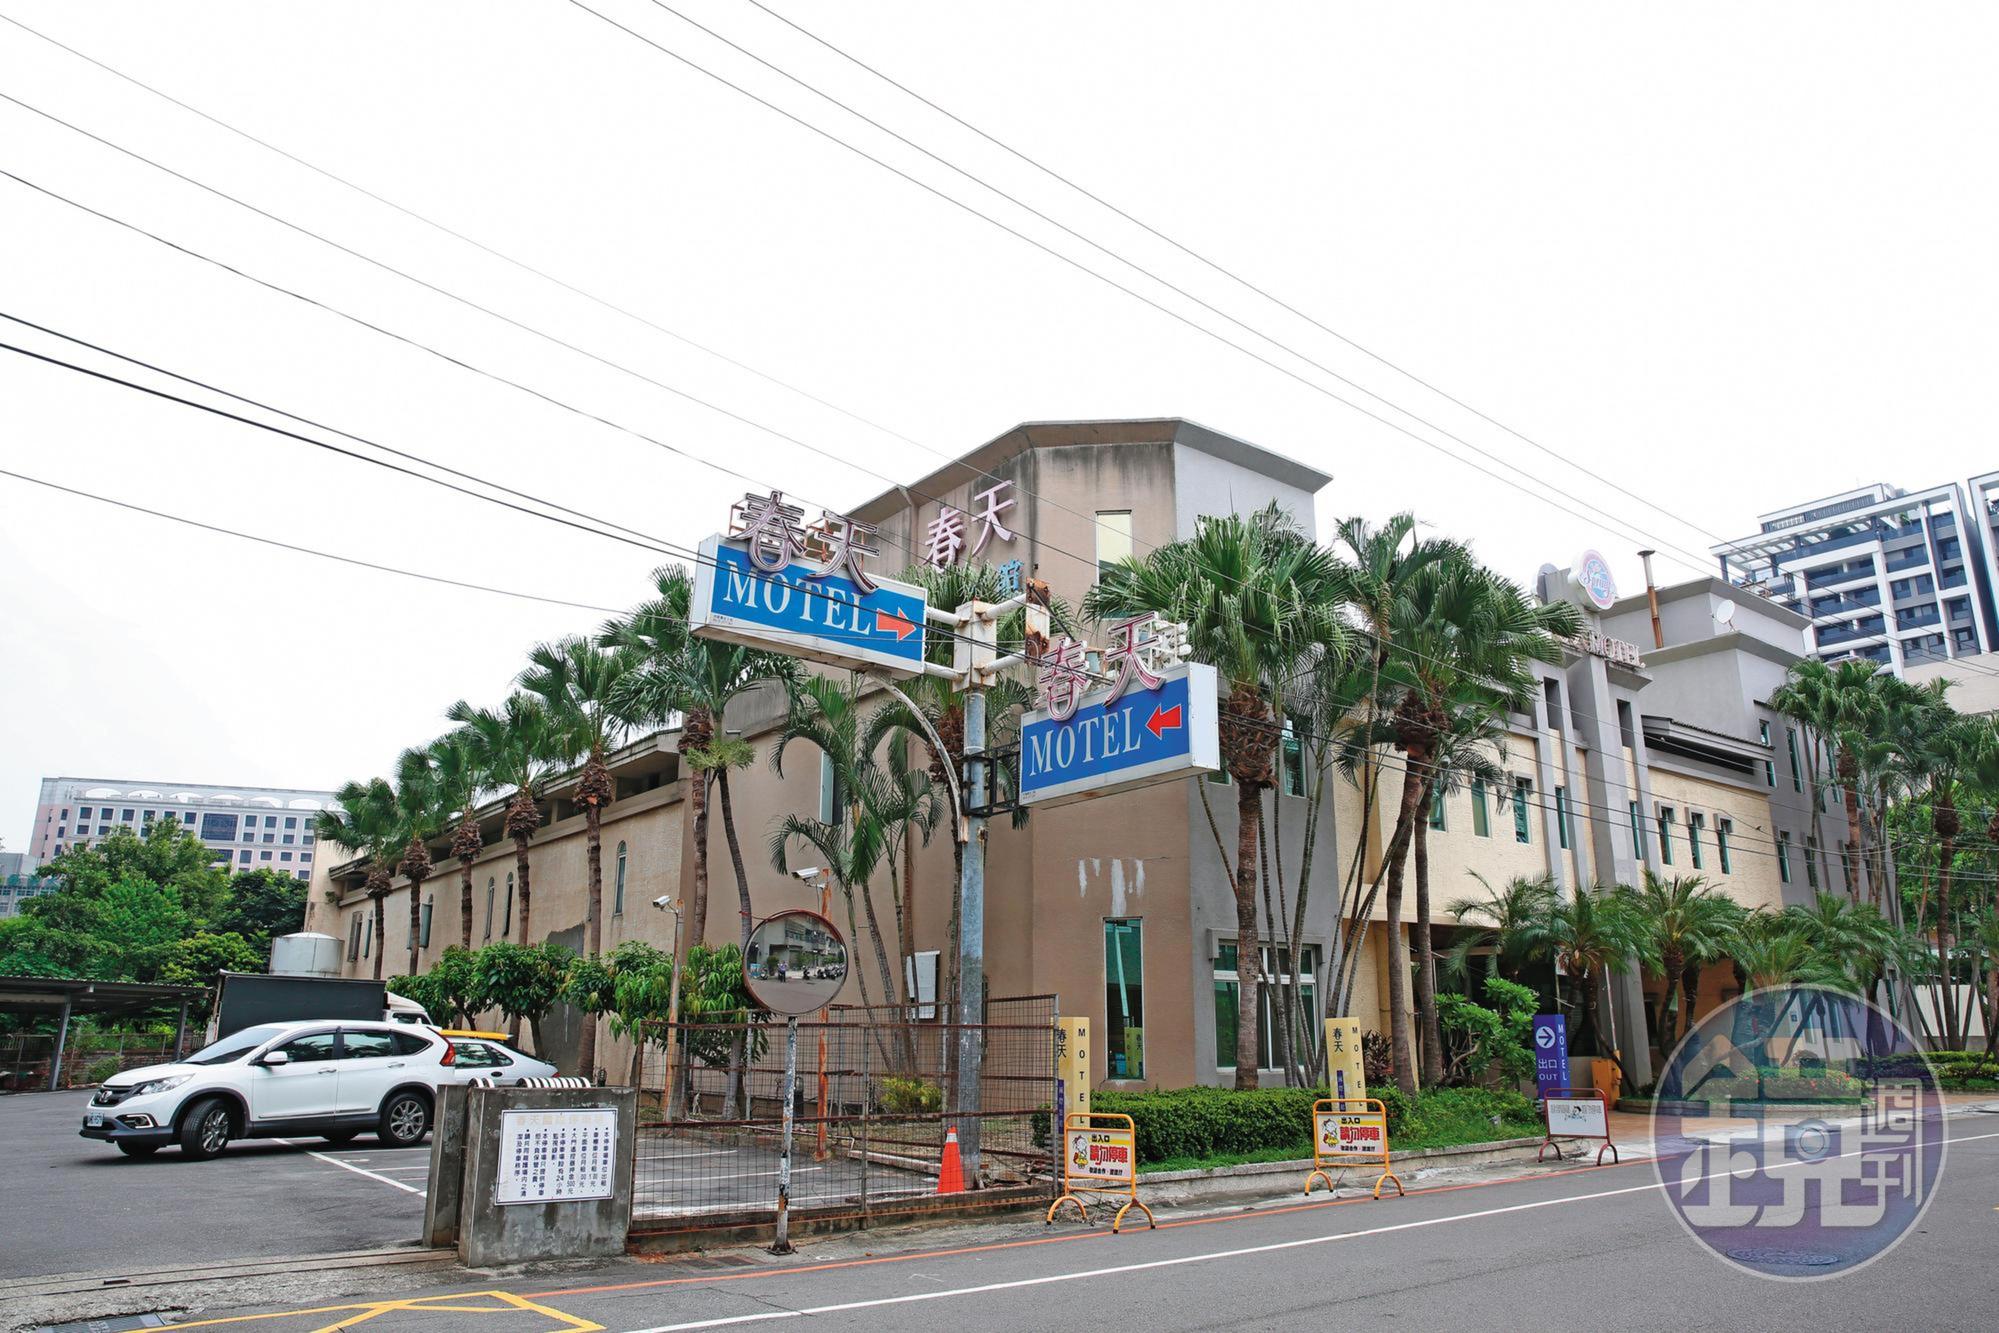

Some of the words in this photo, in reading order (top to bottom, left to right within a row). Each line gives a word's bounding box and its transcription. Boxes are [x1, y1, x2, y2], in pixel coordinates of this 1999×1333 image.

[728, 490, 881, 595] 春天
[922, 480, 1016, 575] 春天
[723, 560, 872, 636] MOTEL
[1034, 611, 1167, 722] 春天
[1029, 706, 1141, 777] MOTEL
[1057, 1028, 1067, 1059] 春天
[1333, 1028, 1343, 1053] 春天
[1558, 1024, 1567, 1081] MOTEL
[1078, 1028, 1086, 1124] MOTEL
[1538, 1073, 1558, 1081] OUT
[1539, 1059, 1558, 1069] 出口
[1340, 1126, 1380, 1144] 請勿停車
[1341, 1117, 1360, 1125] 出入口
[1091, 1134, 1110, 1143] 出入口
[1090, 1144, 1128, 1165] 請勿停車
